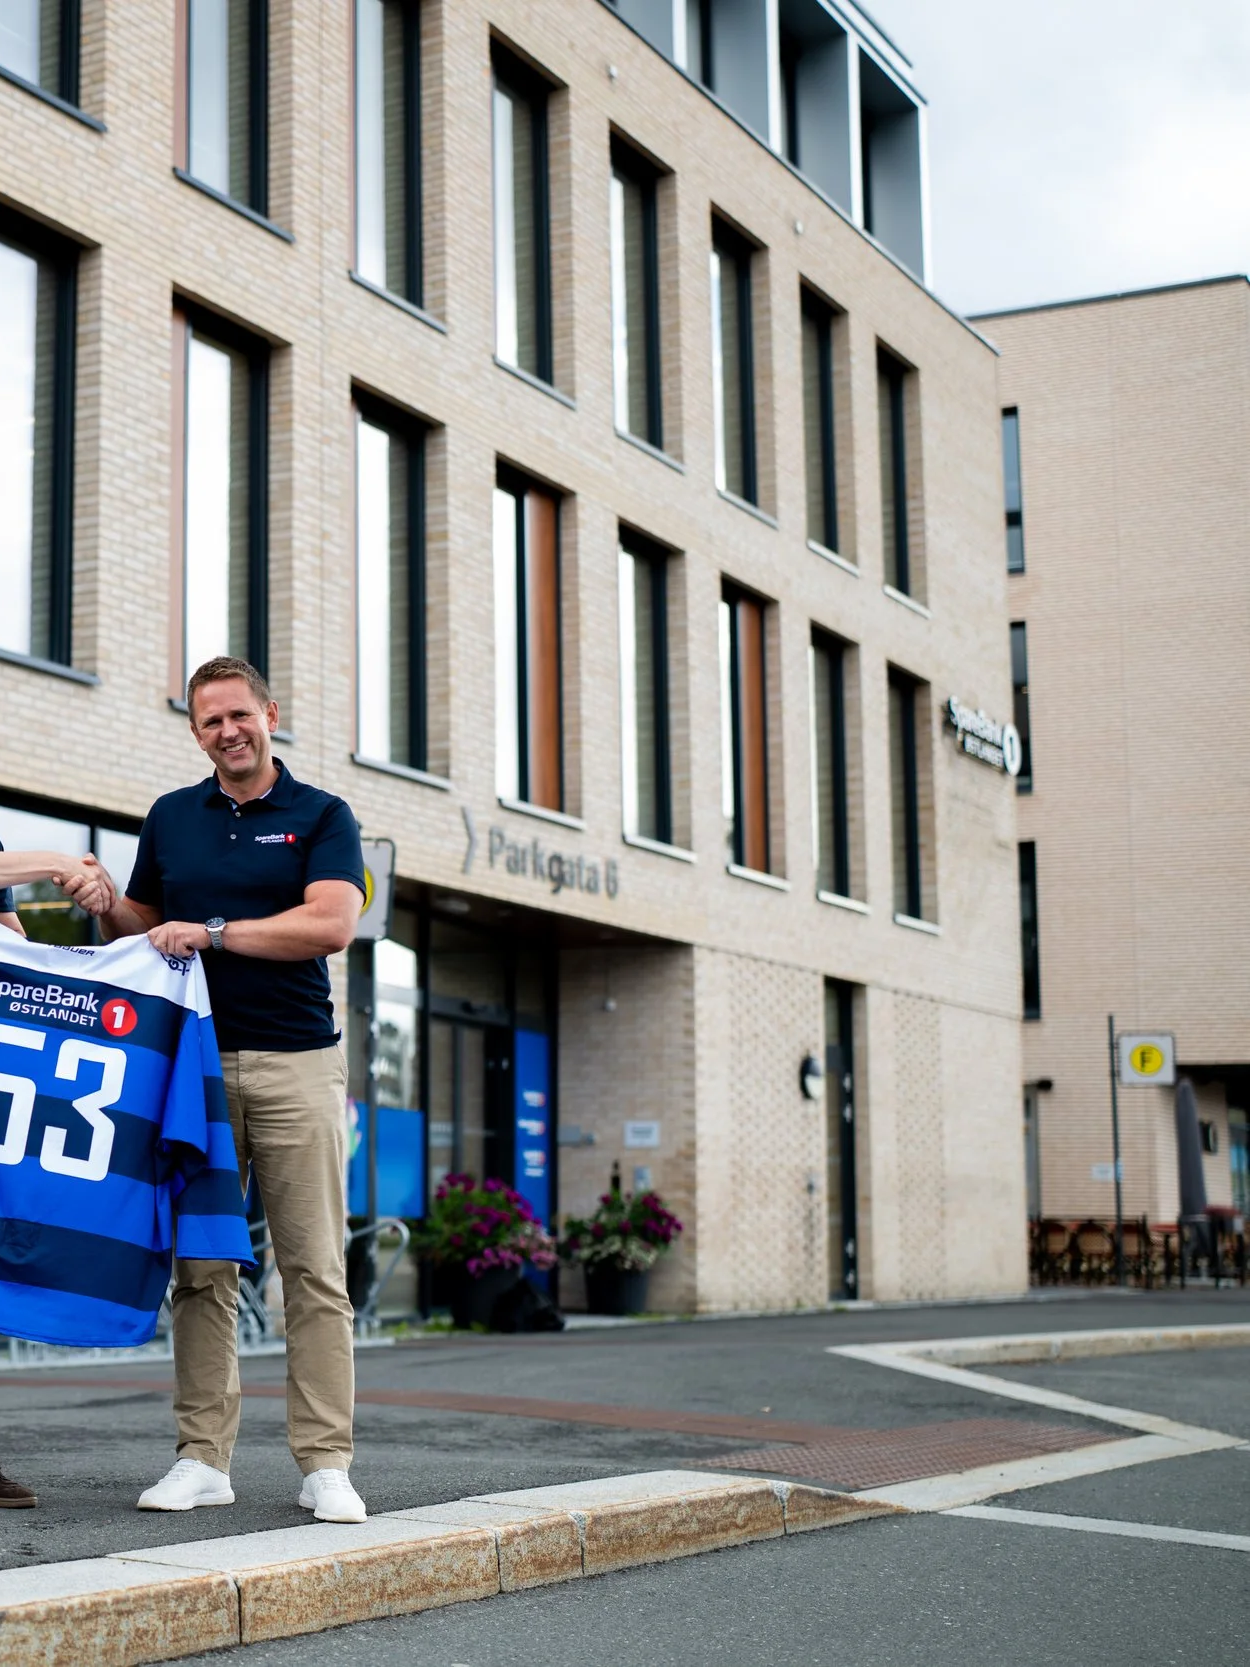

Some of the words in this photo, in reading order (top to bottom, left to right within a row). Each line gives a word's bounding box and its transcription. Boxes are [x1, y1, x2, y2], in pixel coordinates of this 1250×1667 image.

[489, 825, 599, 895] Parkgata
[9, 1001, 98, 1027] ØSTLANDET
[112, 1005, 126, 1029] 1
[1139, 1048, 1153, 1073] F
